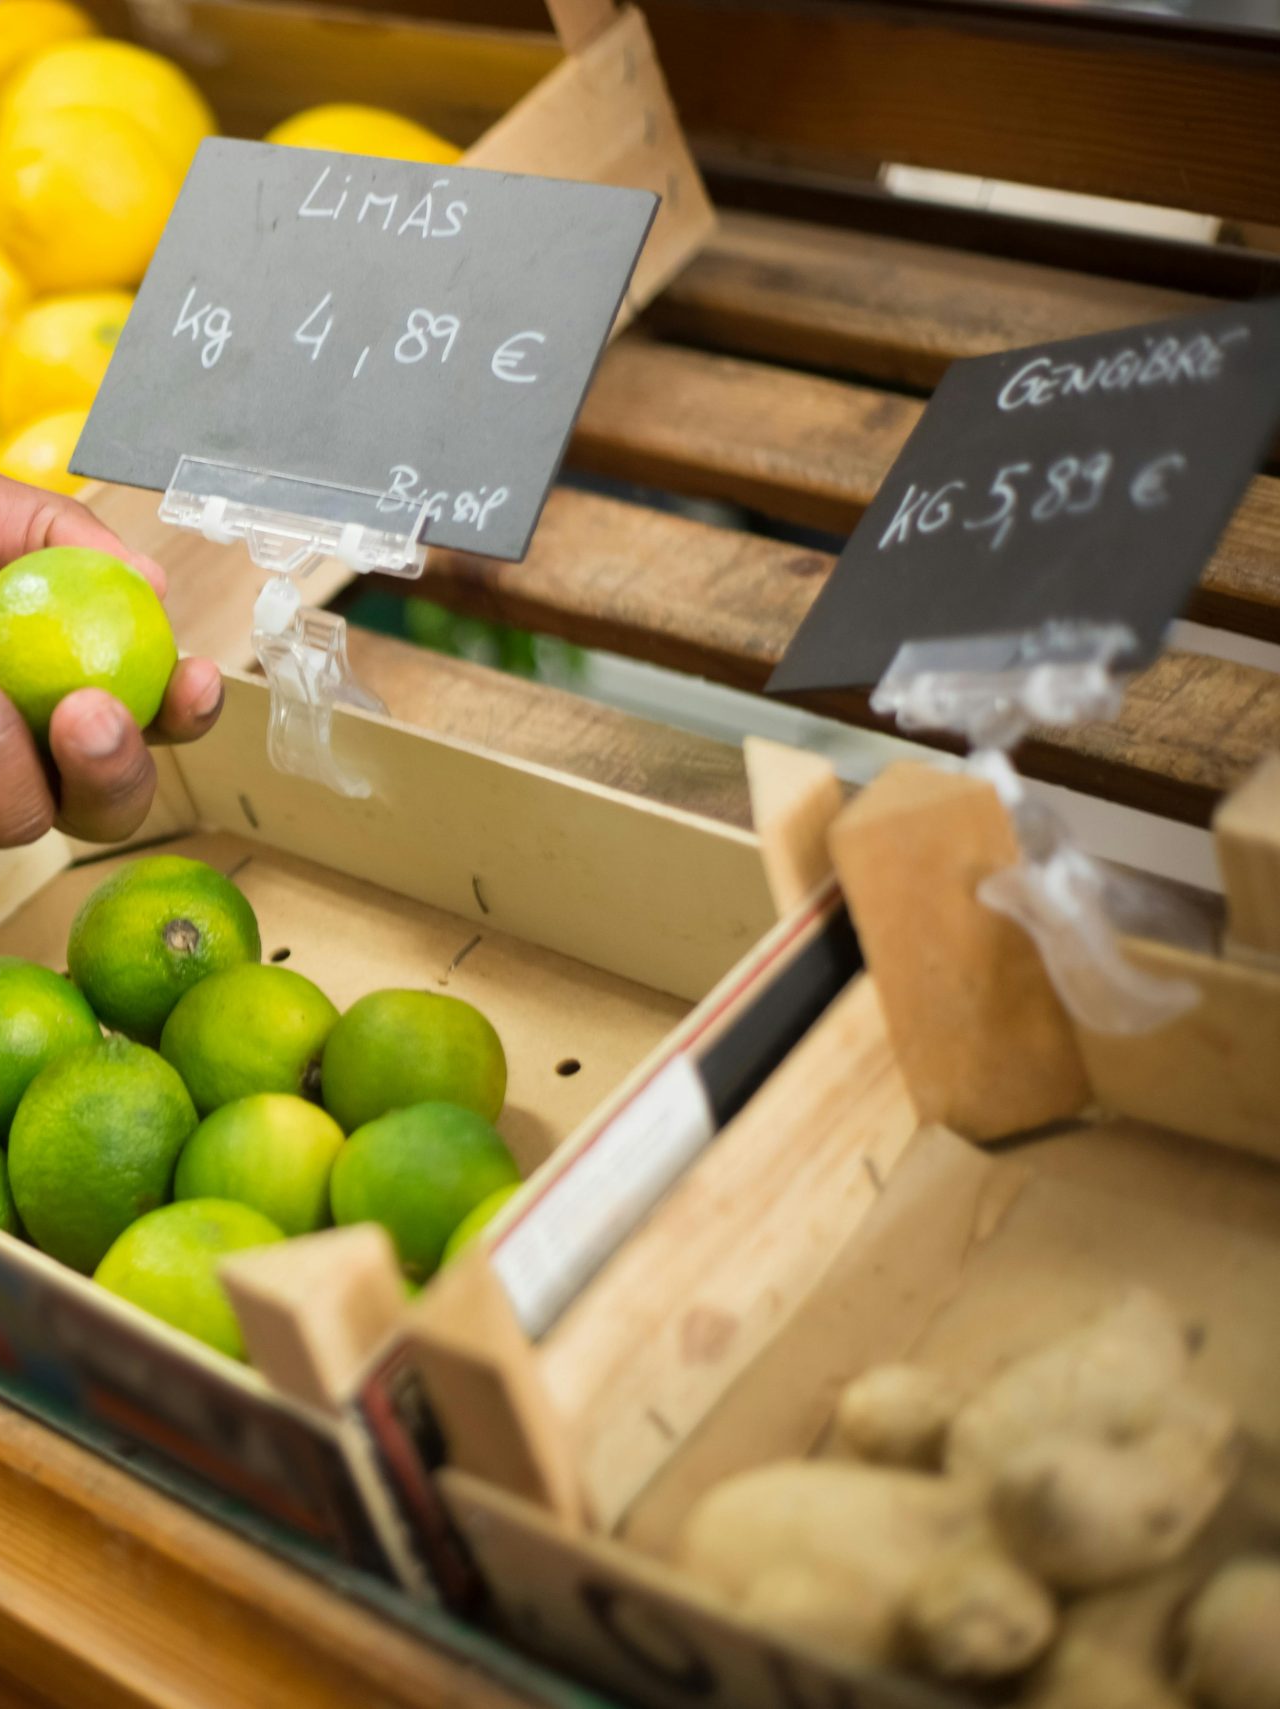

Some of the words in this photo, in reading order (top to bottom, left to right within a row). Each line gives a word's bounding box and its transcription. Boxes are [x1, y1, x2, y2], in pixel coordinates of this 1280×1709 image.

[490, 331, 546, 383] €
[878, 482, 966, 550] KG
[964, 451, 1113, 551] 5,89
[1130, 452, 1187, 509] €
